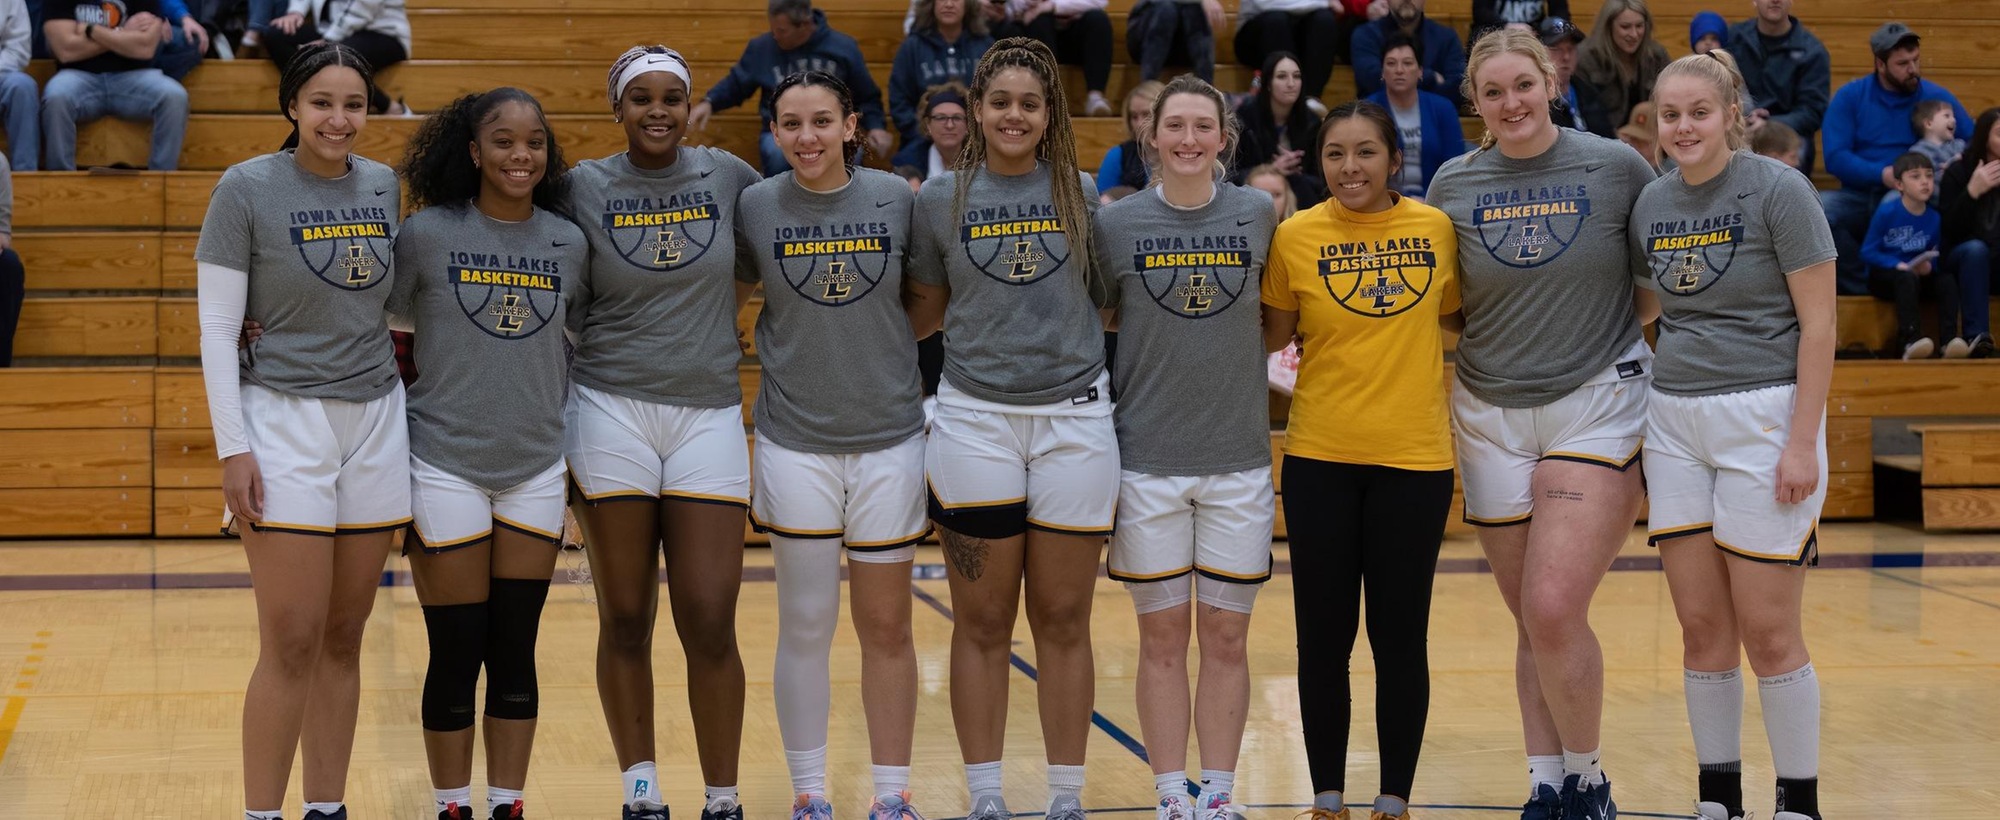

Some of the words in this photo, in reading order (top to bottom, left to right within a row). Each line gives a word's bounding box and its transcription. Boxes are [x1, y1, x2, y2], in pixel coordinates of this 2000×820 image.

[606, 197, 652, 211] IOWA
[658, 191, 714, 209] LAKES
[1476, 190, 1521, 207] IOWA
[1528, 185, 1586, 200] LAKES
[290, 210, 337, 224] IOWA
[341, 207, 386, 220] LAKES
[614, 206, 710, 227] BASKETBALL
[1017, 204, 1058, 217] LAK
[1483, 201, 1578, 221] BASKETBALL
[303, 224, 386, 241] BASKETBALL
[775, 226, 824, 240] IOWA
[830, 222, 888, 238] LAKES
[1651, 220, 1687, 235] IOWA
[1692, 213, 1742, 231] LAKES
[643, 239, 688, 252] LAKERS
[784, 238, 882, 256] BASKETBALL
[1136, 237, 1184, 252] IOWA
[1191, 236, 1248, 249] LAKES
[1320, 241, 1368, 258] IOWA
[1375, 238, 1431, 253] LAKES
[1508, 235, 1550, 247] LAKERS
[1653, 229, 1732, 251] BASKETBALL
[337, 257, 377, 268] LAKERS
[450, 251, 500, 267] IOWA
[508, 255, 559, 273] LAKES
[1000, 251, 1045, 264] LAKERS
[1145, 252, 1242, 268] BASKETBALL
[1330, 253, 1427, 272] BASKETBALL
[1671, 264, 1706, 276] LAKERS
[461, 269, 554, 289] BASKETBALL
[814, 273, 858, 285] LAKERS
[1176, 286, 1218, 297] LAKERS
[1360, 284, 1406, 298] LAKERS
[489, 305, 531, 318] LAKERS
